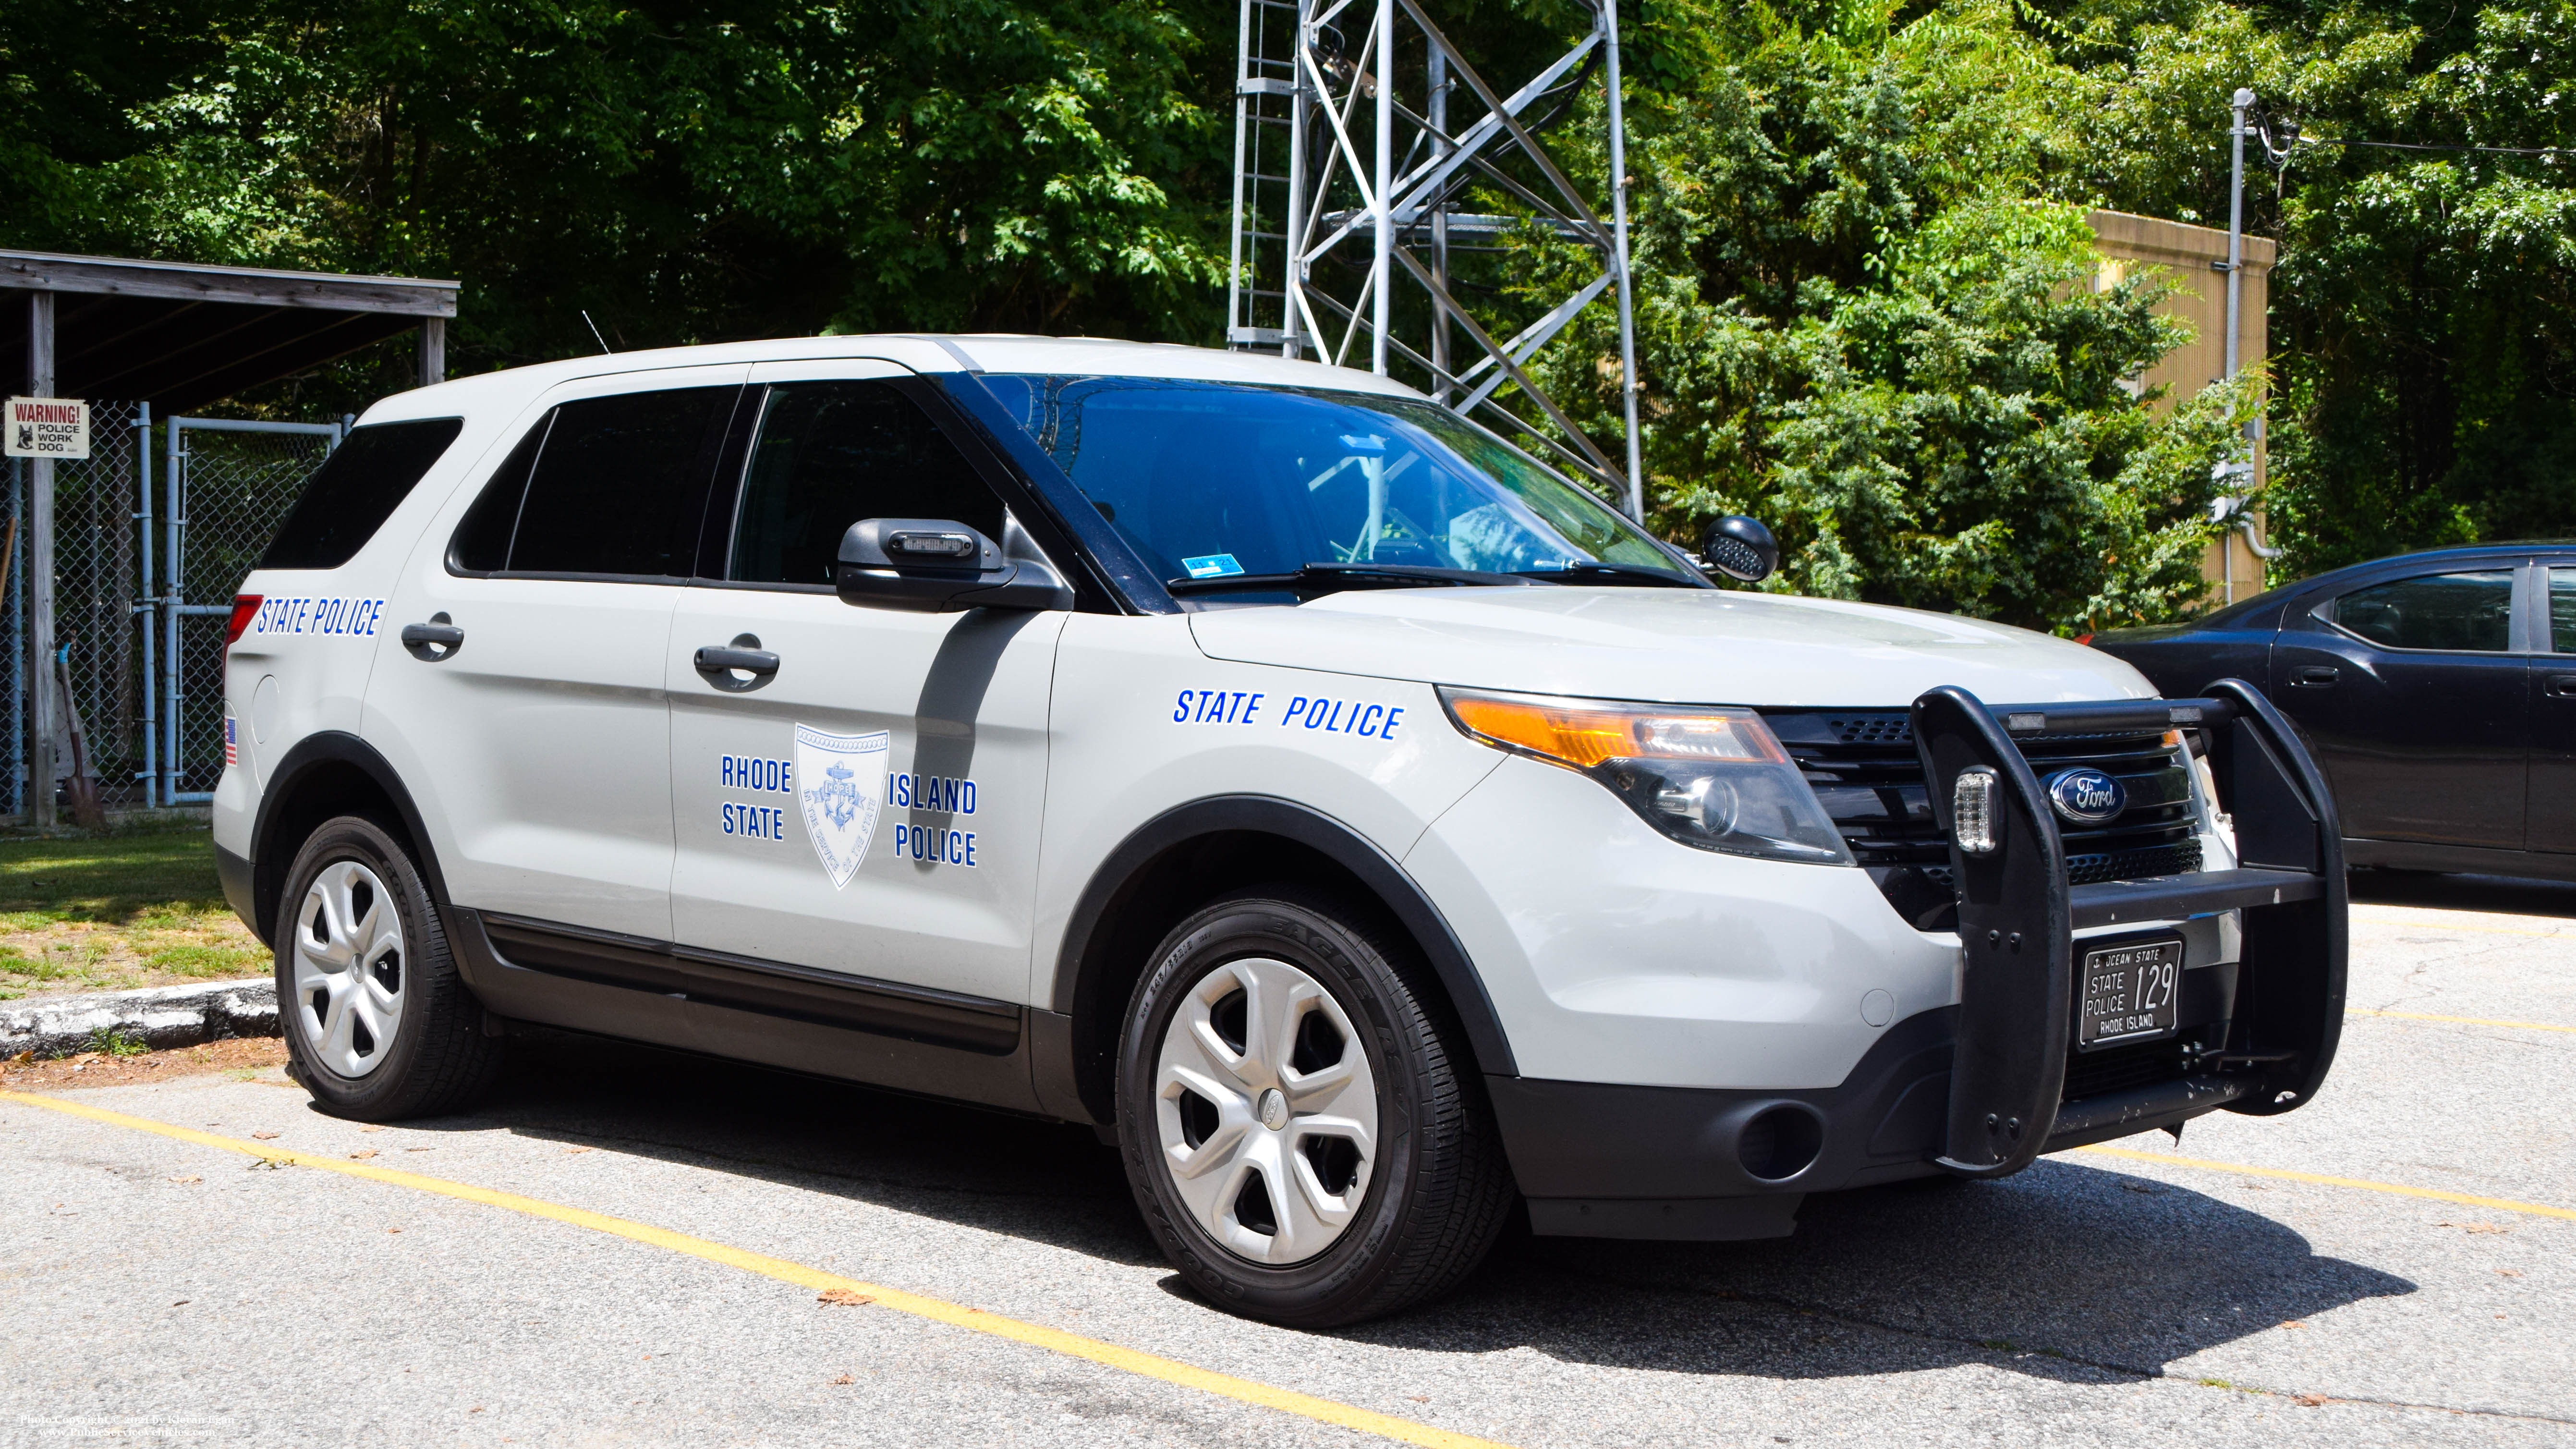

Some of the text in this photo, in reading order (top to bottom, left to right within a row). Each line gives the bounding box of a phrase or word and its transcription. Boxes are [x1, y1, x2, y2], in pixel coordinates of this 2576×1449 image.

[15, 403, 80, 424] WARNING!
[38, 424, 80, 433] POLICE
[38, 434, 73, 442] WORK
[38, 443, 64, 451] DOG
[257, 597, 385, 637] STATE POLICE
[1173, 689, 1406, 742] STATE POLICE
[722, 755, 791, 794] RHODE
[829, 784, 850, 793] HOPE
[888, 772, 977, 815] ISLAND
[2076, 777, 2115, 808] Ford
[722, 803, 783, 841] STATE
[803, 789, 812, 802] IN
[815, 829, 839, 872] SERVICE
[851, 835, 864, 856] THE
[861, 798, 876, 834] STATE
[896, 823, 977, 867] POLICE
[2105, 949, 2159, 967] OCEAN STATE
[2091, 972, 2125, 994] STATE
[2135, 962, 2173, 1011] 129
[2086, 994, 2125, 1017] POLICE
[2100, 1013, 2152, 1034] RHODE ISLAND
